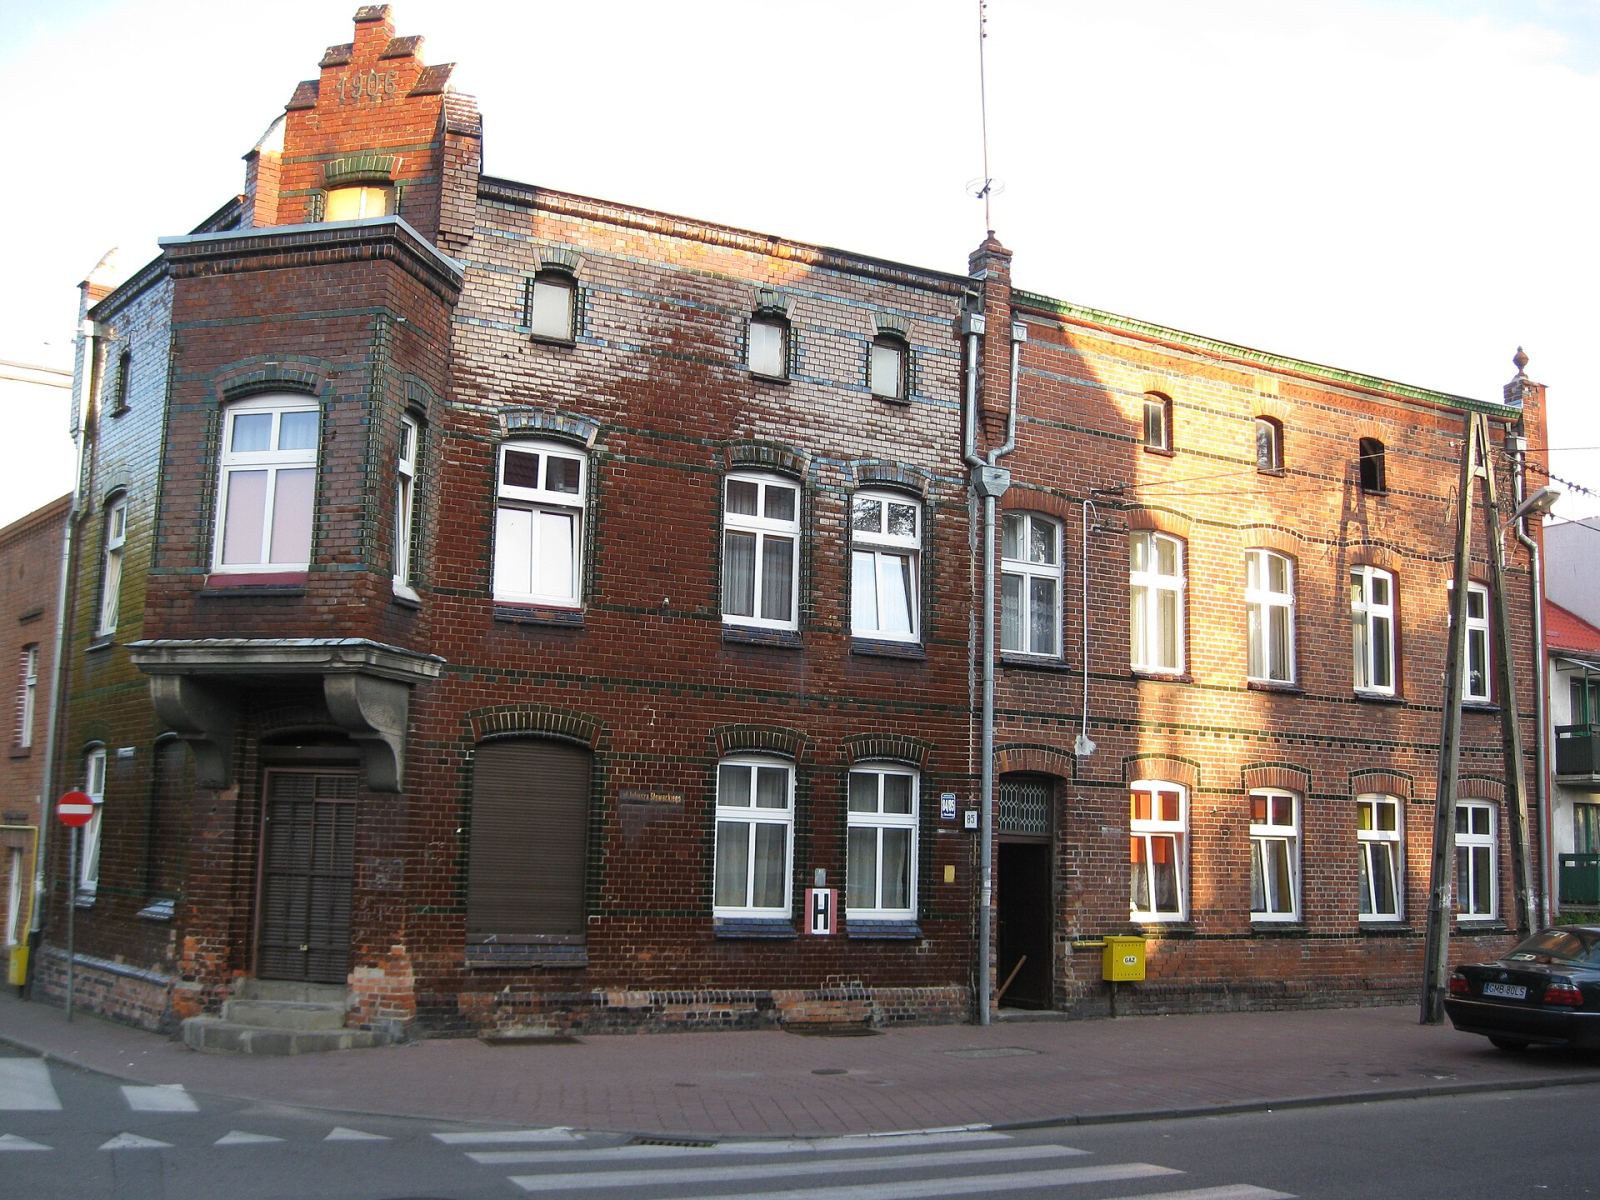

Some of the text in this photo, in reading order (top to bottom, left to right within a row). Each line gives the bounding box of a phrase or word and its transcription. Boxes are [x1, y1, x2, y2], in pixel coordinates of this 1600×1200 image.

[335, 69, 397, 100] 1906
[966, 814, 976, 824] 85
[813, 893, 829, 930] H
